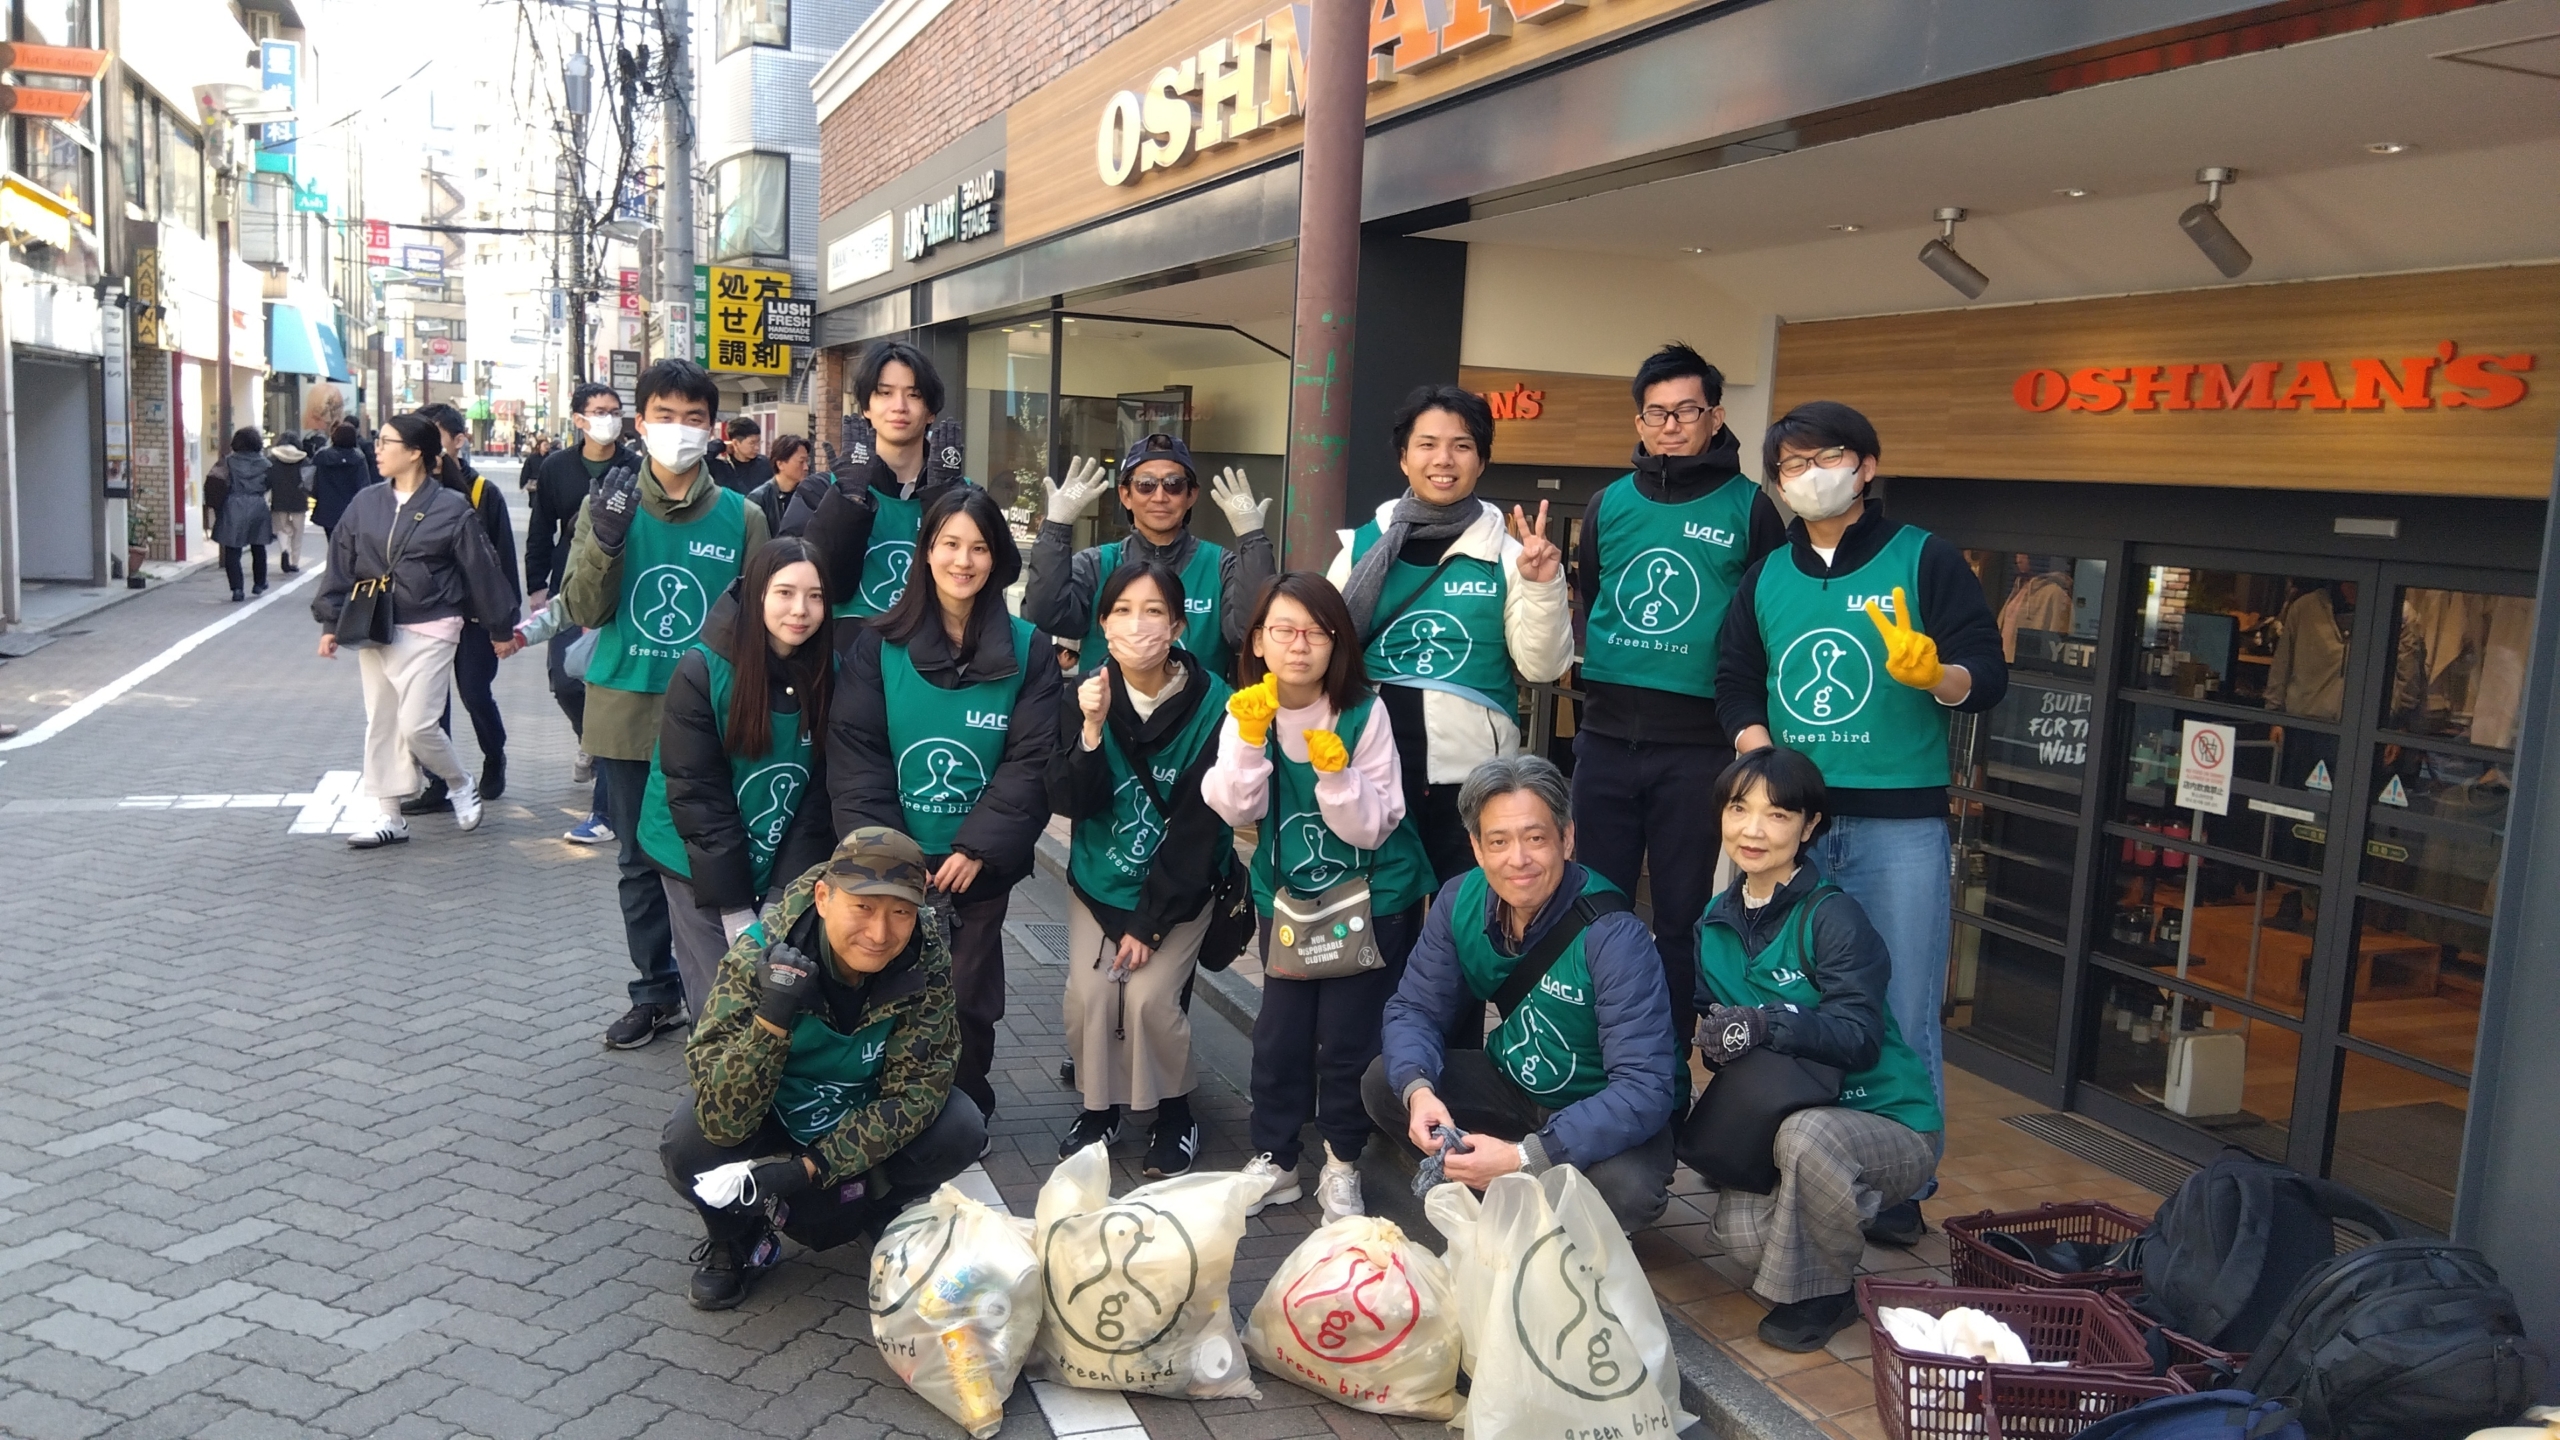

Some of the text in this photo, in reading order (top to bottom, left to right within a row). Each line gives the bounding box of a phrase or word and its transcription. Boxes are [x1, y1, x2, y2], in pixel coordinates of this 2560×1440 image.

[961, 169, 996, 210] GRAND
[961, 203, 991, 241] STAGE
[138, 254, 155, 338] KABNA
[718, 272, 783, 302] 処方
[768, 301, 811, 316] LUSH
[768, 314, 811, 327] FRESH
[768, 325, 810, 335] HANDMADE
[768, 333, 810, 342] COSMETICS
[718, 339, 780, 368] 調剤
[2012, 340, 2535, 413] OSHMAN'S
[1685, 521, 1735, 546] UACJ
[689, 540, 735, 560] UACJ
[1444, 581, 1497, 595] UACJ
[1847, 594, 1895, 609] UAC
[629, 643, 668, 658] green
[1607, 632, 1689, 655] green bird
[966, 710, 1009, 727] UAC
[1782, 728, 1870, 743] green bird
[901, 793, 944, 813] green
[1105, 846, 1137, 877] green
[1311, 934, 1326, 945] NON
[1305, 950, 1339, 965] CLOTHING
[1541, 973, 1584, 1002] UACJ
[879, 1334, 916, 1357] bird
[1059, 1355, 1177, 1383] green bird
[1276, 1346, 1390, 1404] green bird
[1631, 1404, 1670, 1437] bird
